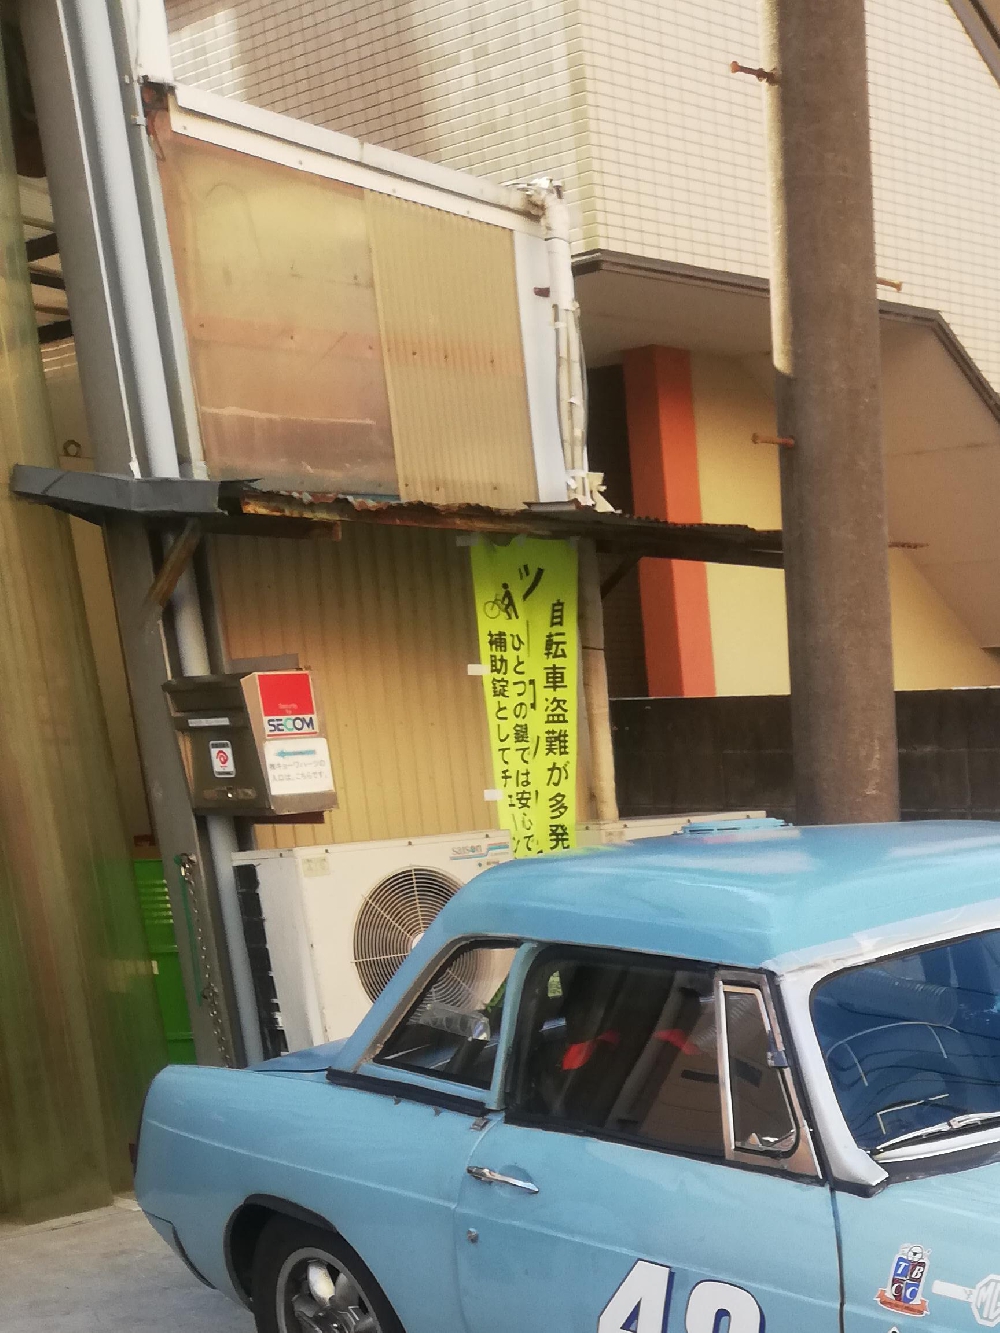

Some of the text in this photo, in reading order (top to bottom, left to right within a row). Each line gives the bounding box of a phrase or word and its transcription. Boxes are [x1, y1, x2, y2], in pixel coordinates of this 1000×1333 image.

[267, 716, 316, 732] SECOM
[543, 599, 571, 851] 自転車盗難が多発
